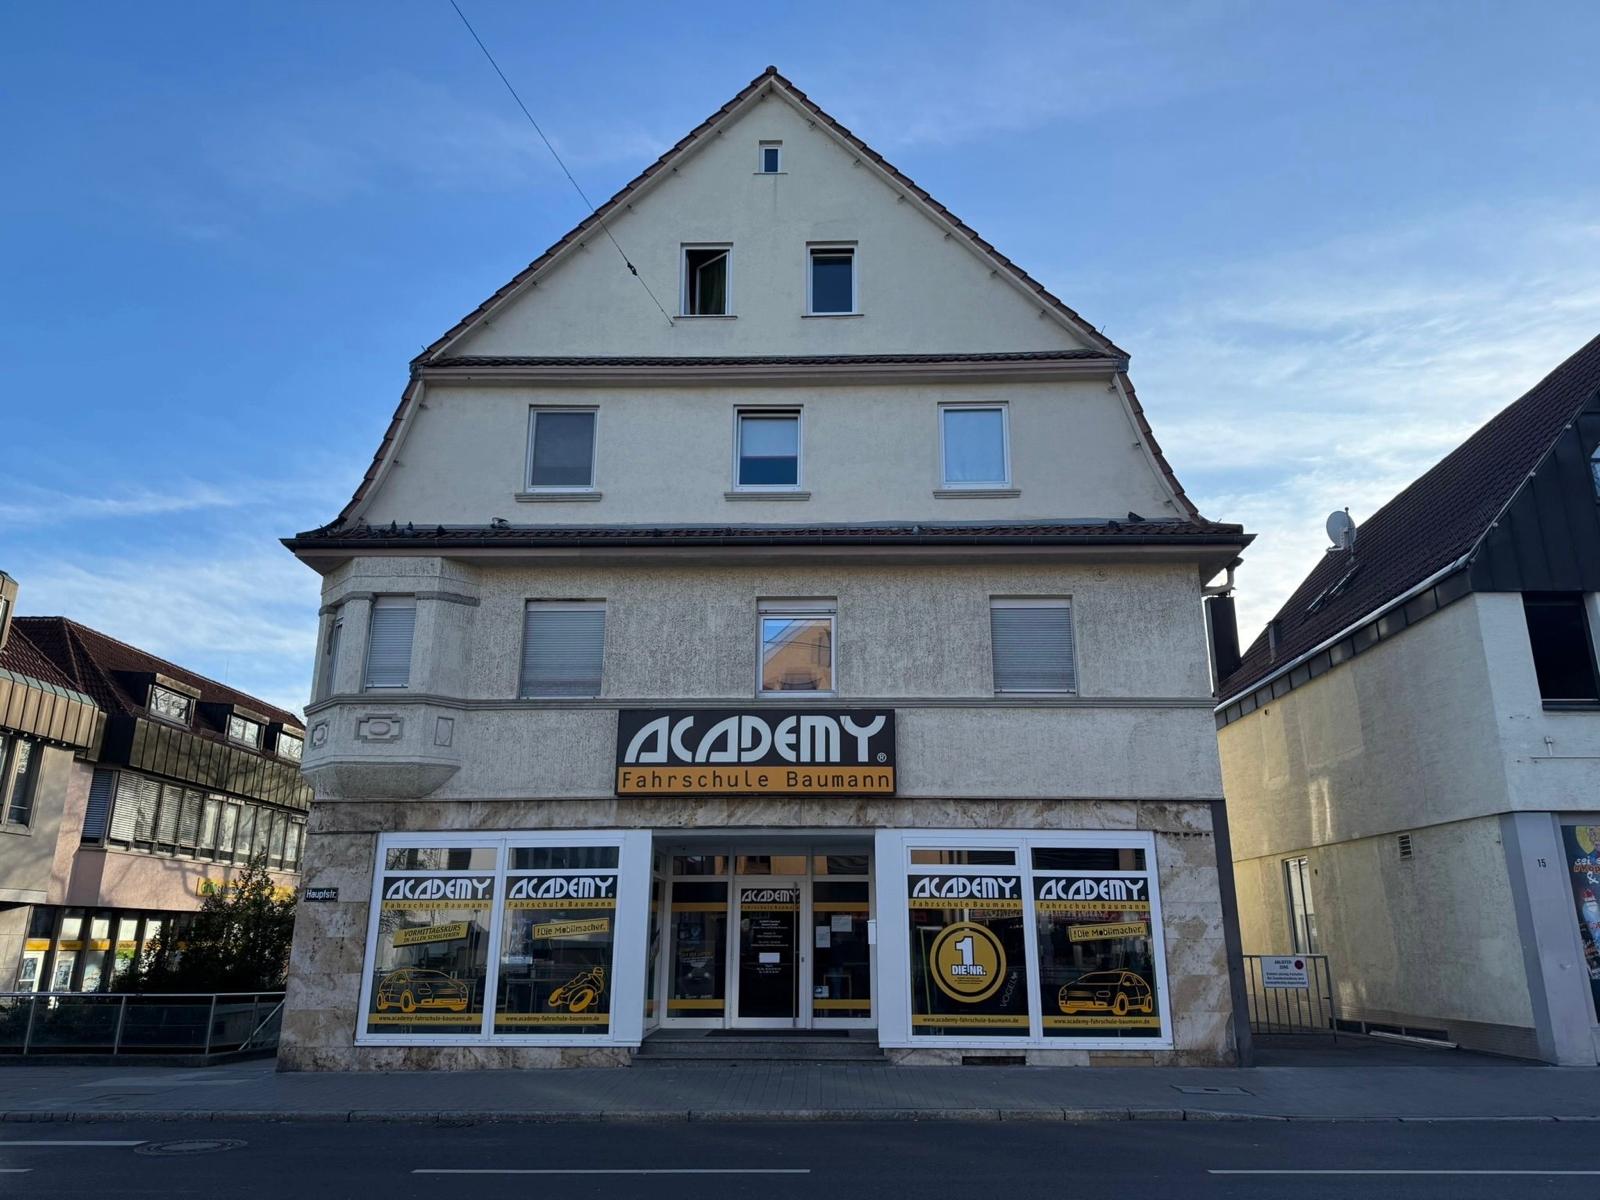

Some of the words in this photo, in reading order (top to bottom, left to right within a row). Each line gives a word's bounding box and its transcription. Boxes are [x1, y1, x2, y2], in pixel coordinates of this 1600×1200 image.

[624, 715, 886, 763] ACADEMY
[622, 770, 769, 788] Fahrschule
[786, 770, 890, 788] Baumann
[1537, 858, 1547, 868] 15
[386, 878, 492, 899] ACADEMY
[508, 877, 614, 899] ACADEMY
[912, 877, 1017, 899] ACADEMY
[1039, 879, 1144, 900] ACADEMY
[384, 901, 441, 909] Fahrschule
[912, 900, 970, 908] Fahrschule
[1039, 902, 1097, 910] Fahrschule
[1101, 902, 1146, 910] Baumann
[403, 923, 462, 938] VORMITTAGSKURS
[952, 965, 967, 976] DIE
